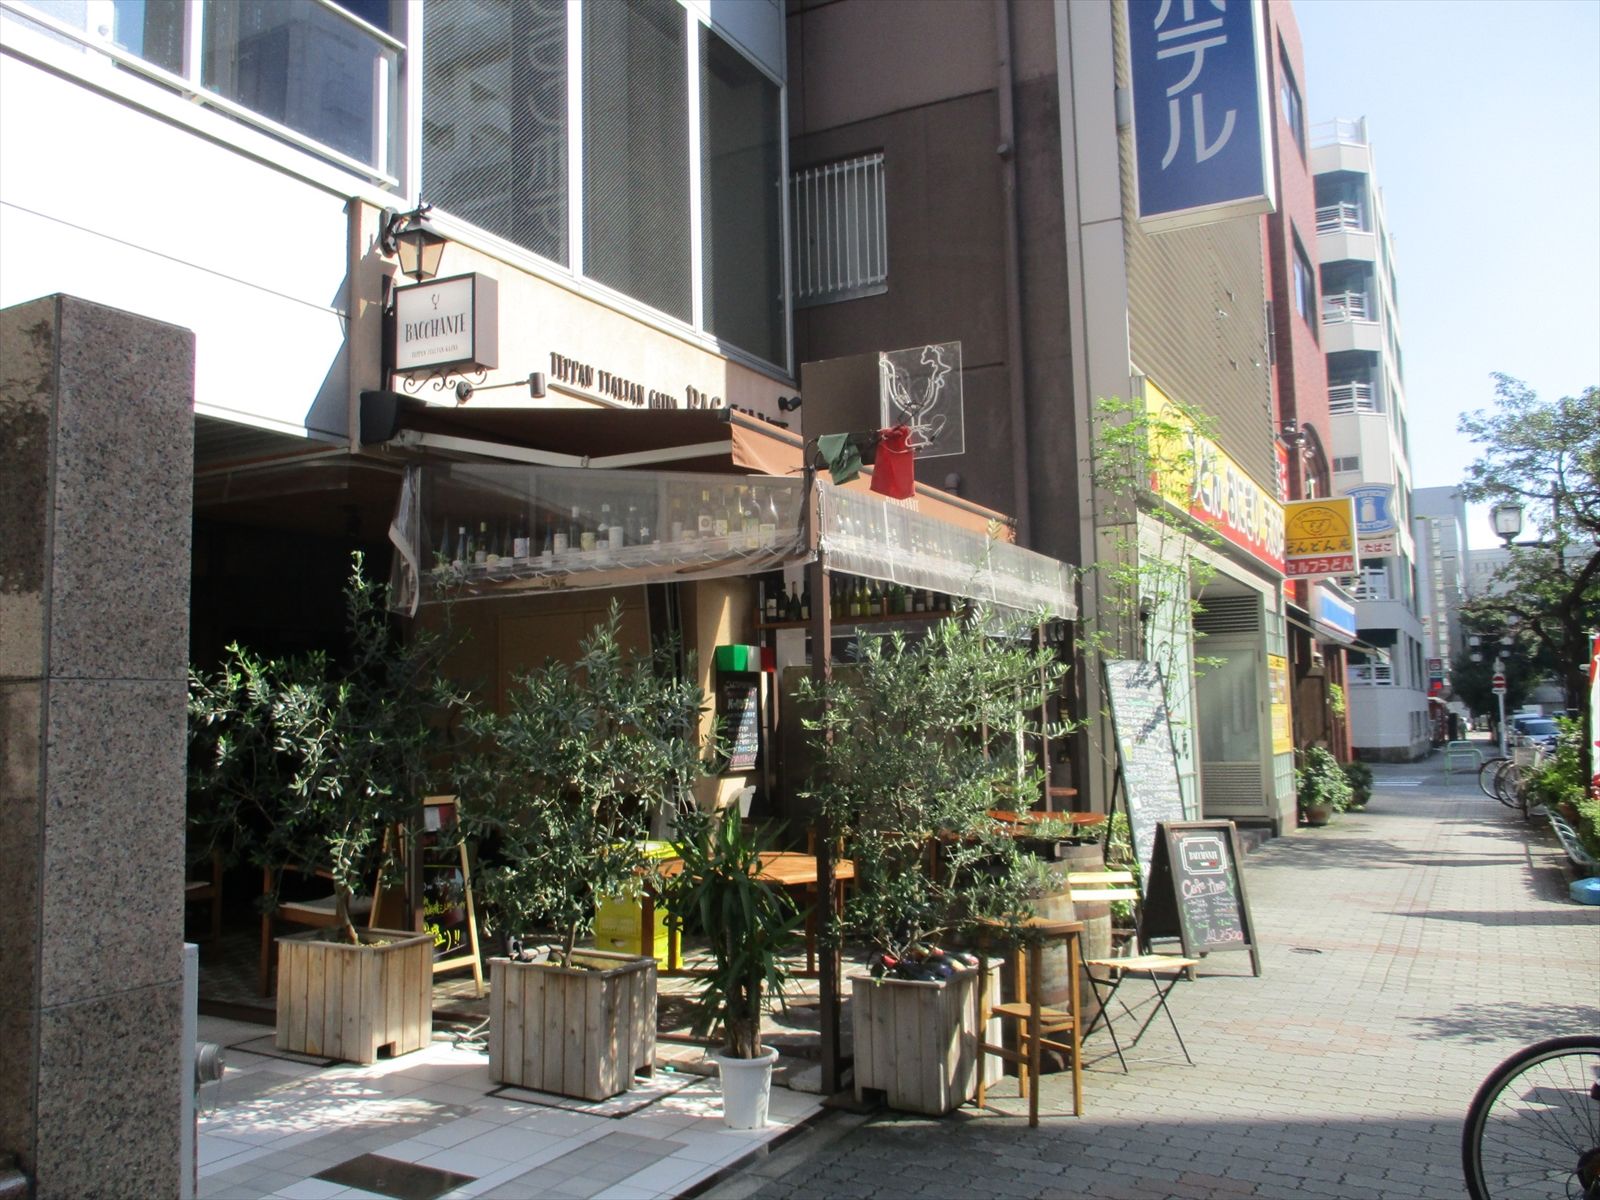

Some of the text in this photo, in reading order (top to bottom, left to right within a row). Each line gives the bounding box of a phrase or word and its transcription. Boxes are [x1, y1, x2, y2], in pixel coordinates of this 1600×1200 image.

[404, 313, 466, 343] BACCHANTE
[550, 351, 594, 389] TEPPAN
[598, 369, 645, 408] ITALIAN
